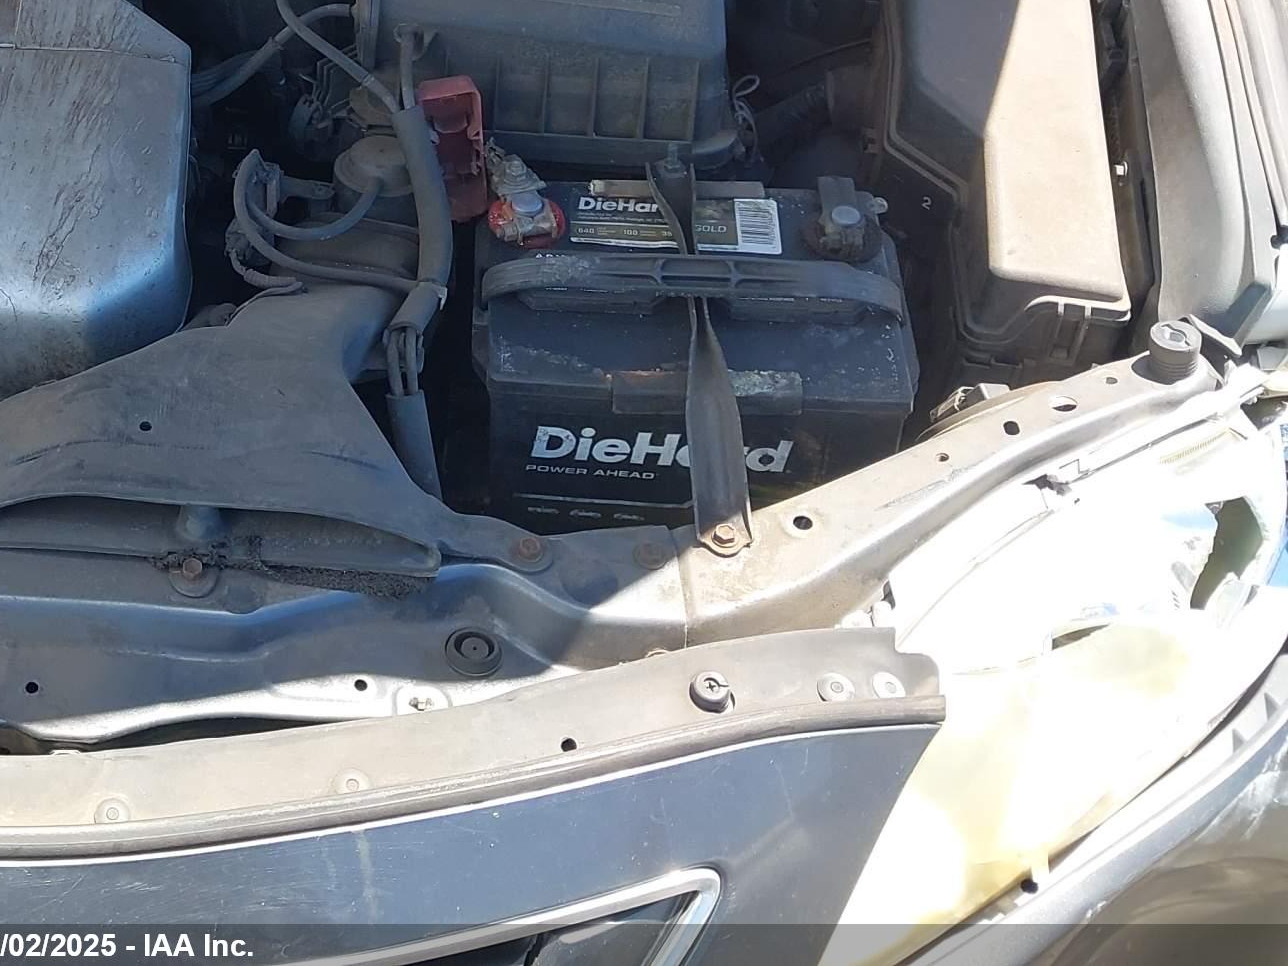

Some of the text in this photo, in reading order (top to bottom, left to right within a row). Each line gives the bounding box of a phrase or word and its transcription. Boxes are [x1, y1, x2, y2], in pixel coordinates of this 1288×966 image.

[578, 196, 660, 213] DieHar
[530, 425, 794, 473] DieHd
[525, 464, 655, 480] POWER AHEAD
